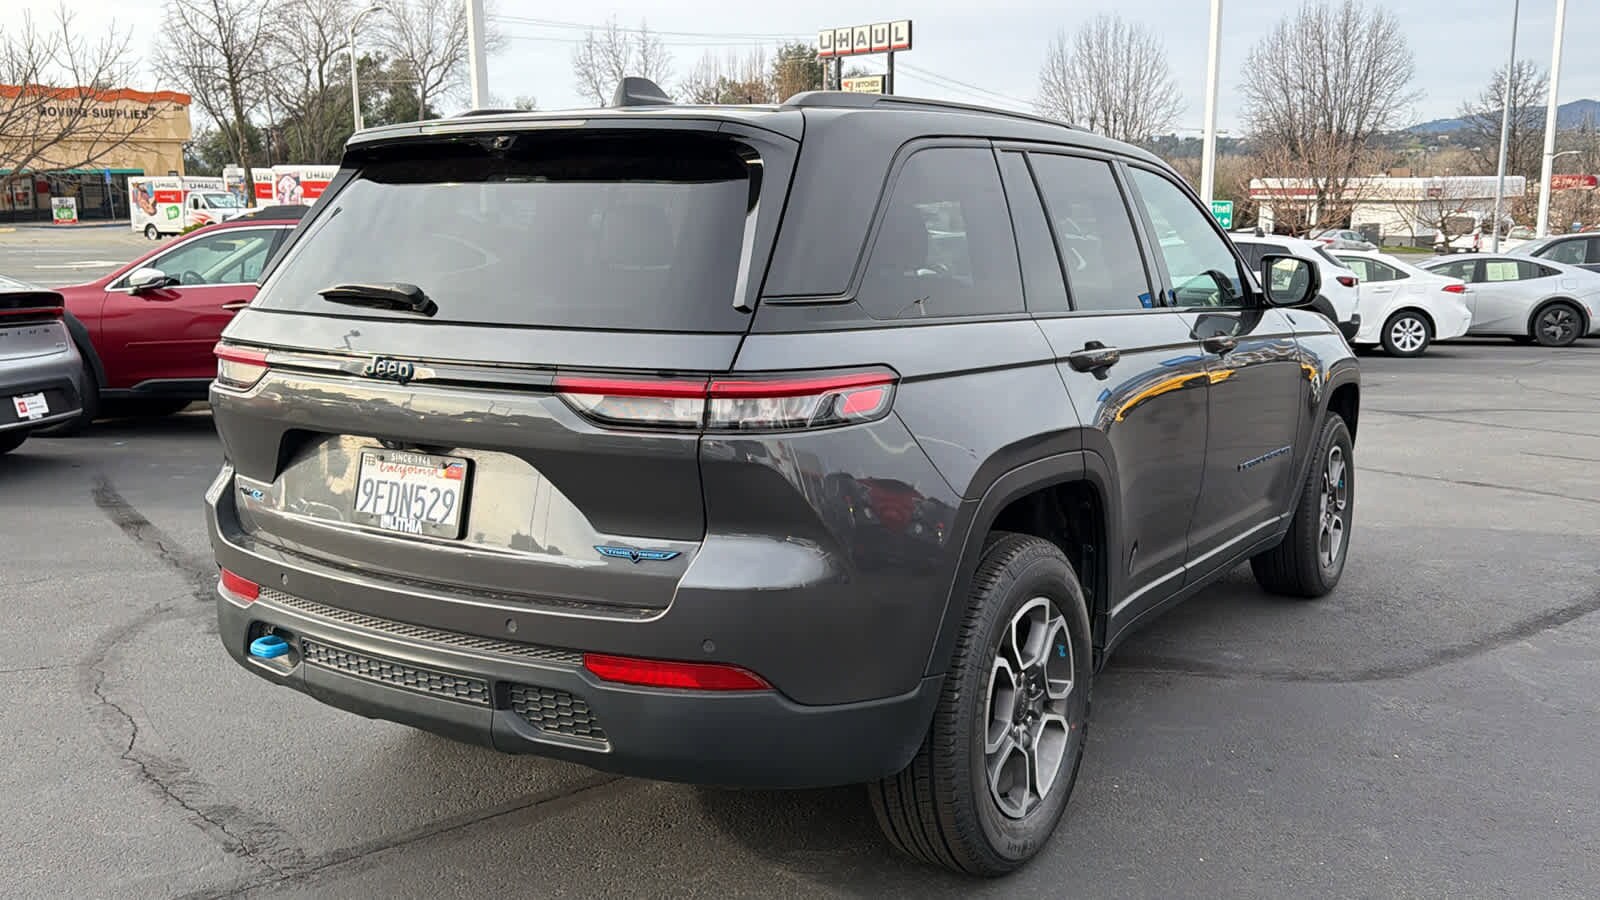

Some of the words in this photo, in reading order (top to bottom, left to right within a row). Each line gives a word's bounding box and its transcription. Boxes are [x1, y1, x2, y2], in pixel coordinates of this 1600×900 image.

[92, 107, 149, 119] SUPPLIES
[361, 355, 415, 385] Jeep
[379, 461, 444, 480] California
[359, 477, 456, 525] 9FDN529
